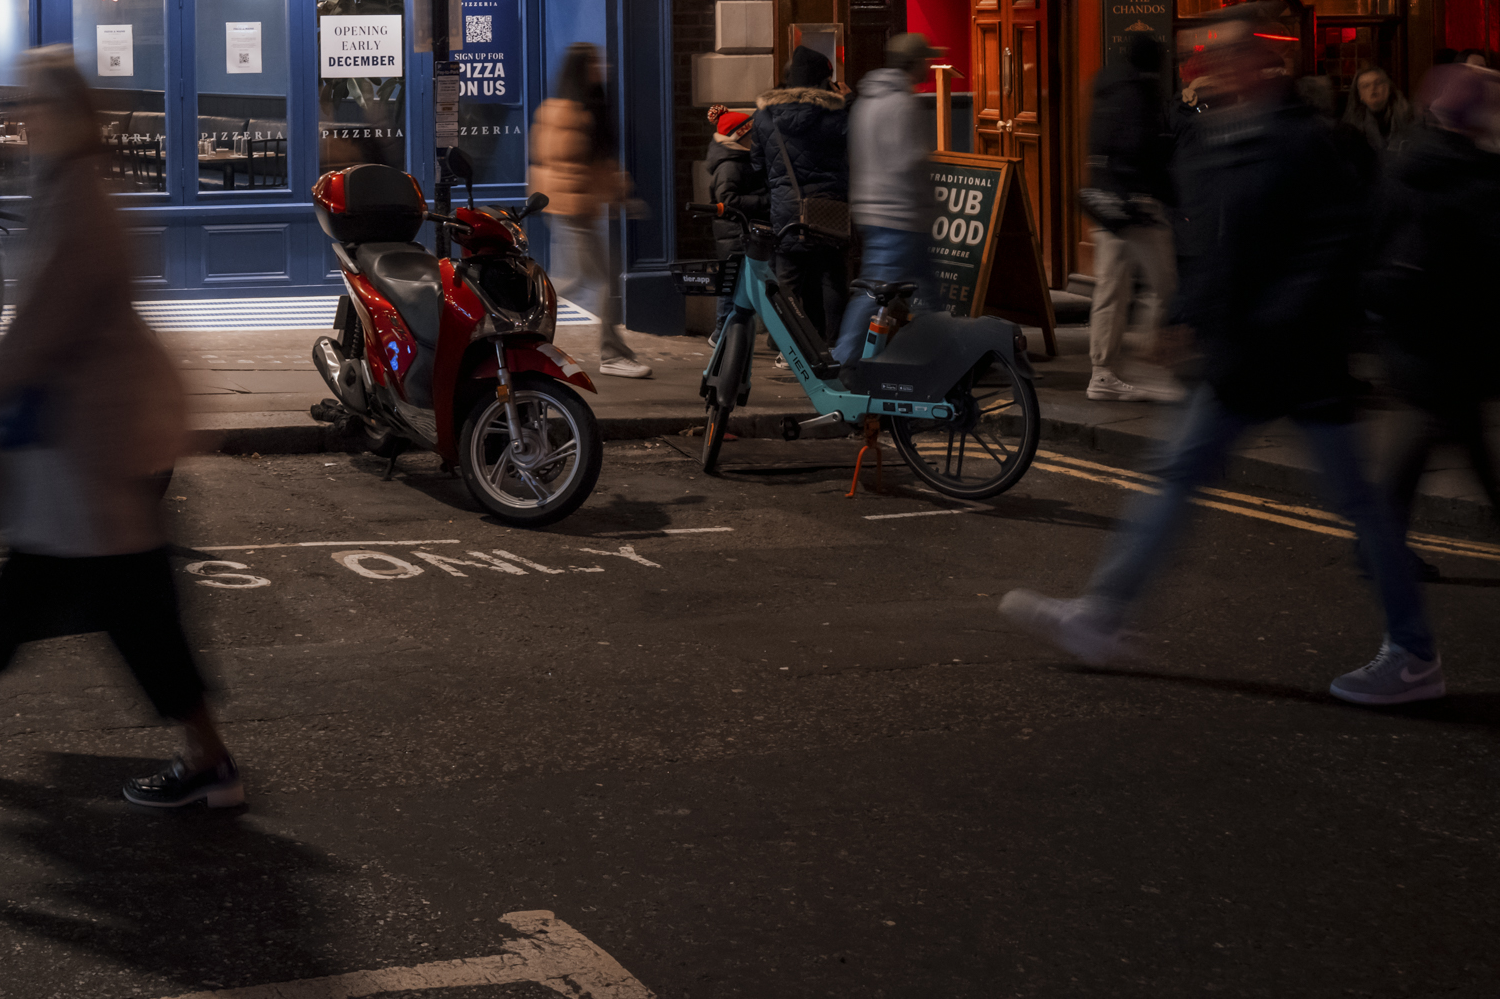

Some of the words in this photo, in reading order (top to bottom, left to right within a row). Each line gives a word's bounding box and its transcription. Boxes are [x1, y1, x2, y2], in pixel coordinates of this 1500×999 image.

[1112, 4, 1166, 15] CHANDOS
[334, 25, 388, 37] OPENING
[341, 40, 381, 51] EARLY
[328, 55, 395, 67] DECEMBER
[454, 53, 474, 61] SIGN
[459, 62, 506, 78] PIZZA
[483, 80, 506, 96] US
[201, 131, 284, 141] PIZZERIA
[322, 128, 404, 139] PIZZERIA
[460, 125, 521, 136] ZZERIA
[930, 173, 992, 187] TRADITIONAL
[934, 186, 983, 215] PUB
[932, 216, 984, 246] OOD
[951, 249, 970, 259] HERE
[682, 274, 711, 284] tier.app
[788, 345, 810, 383] TIER
[331, 544, 662, 580] ONLY
